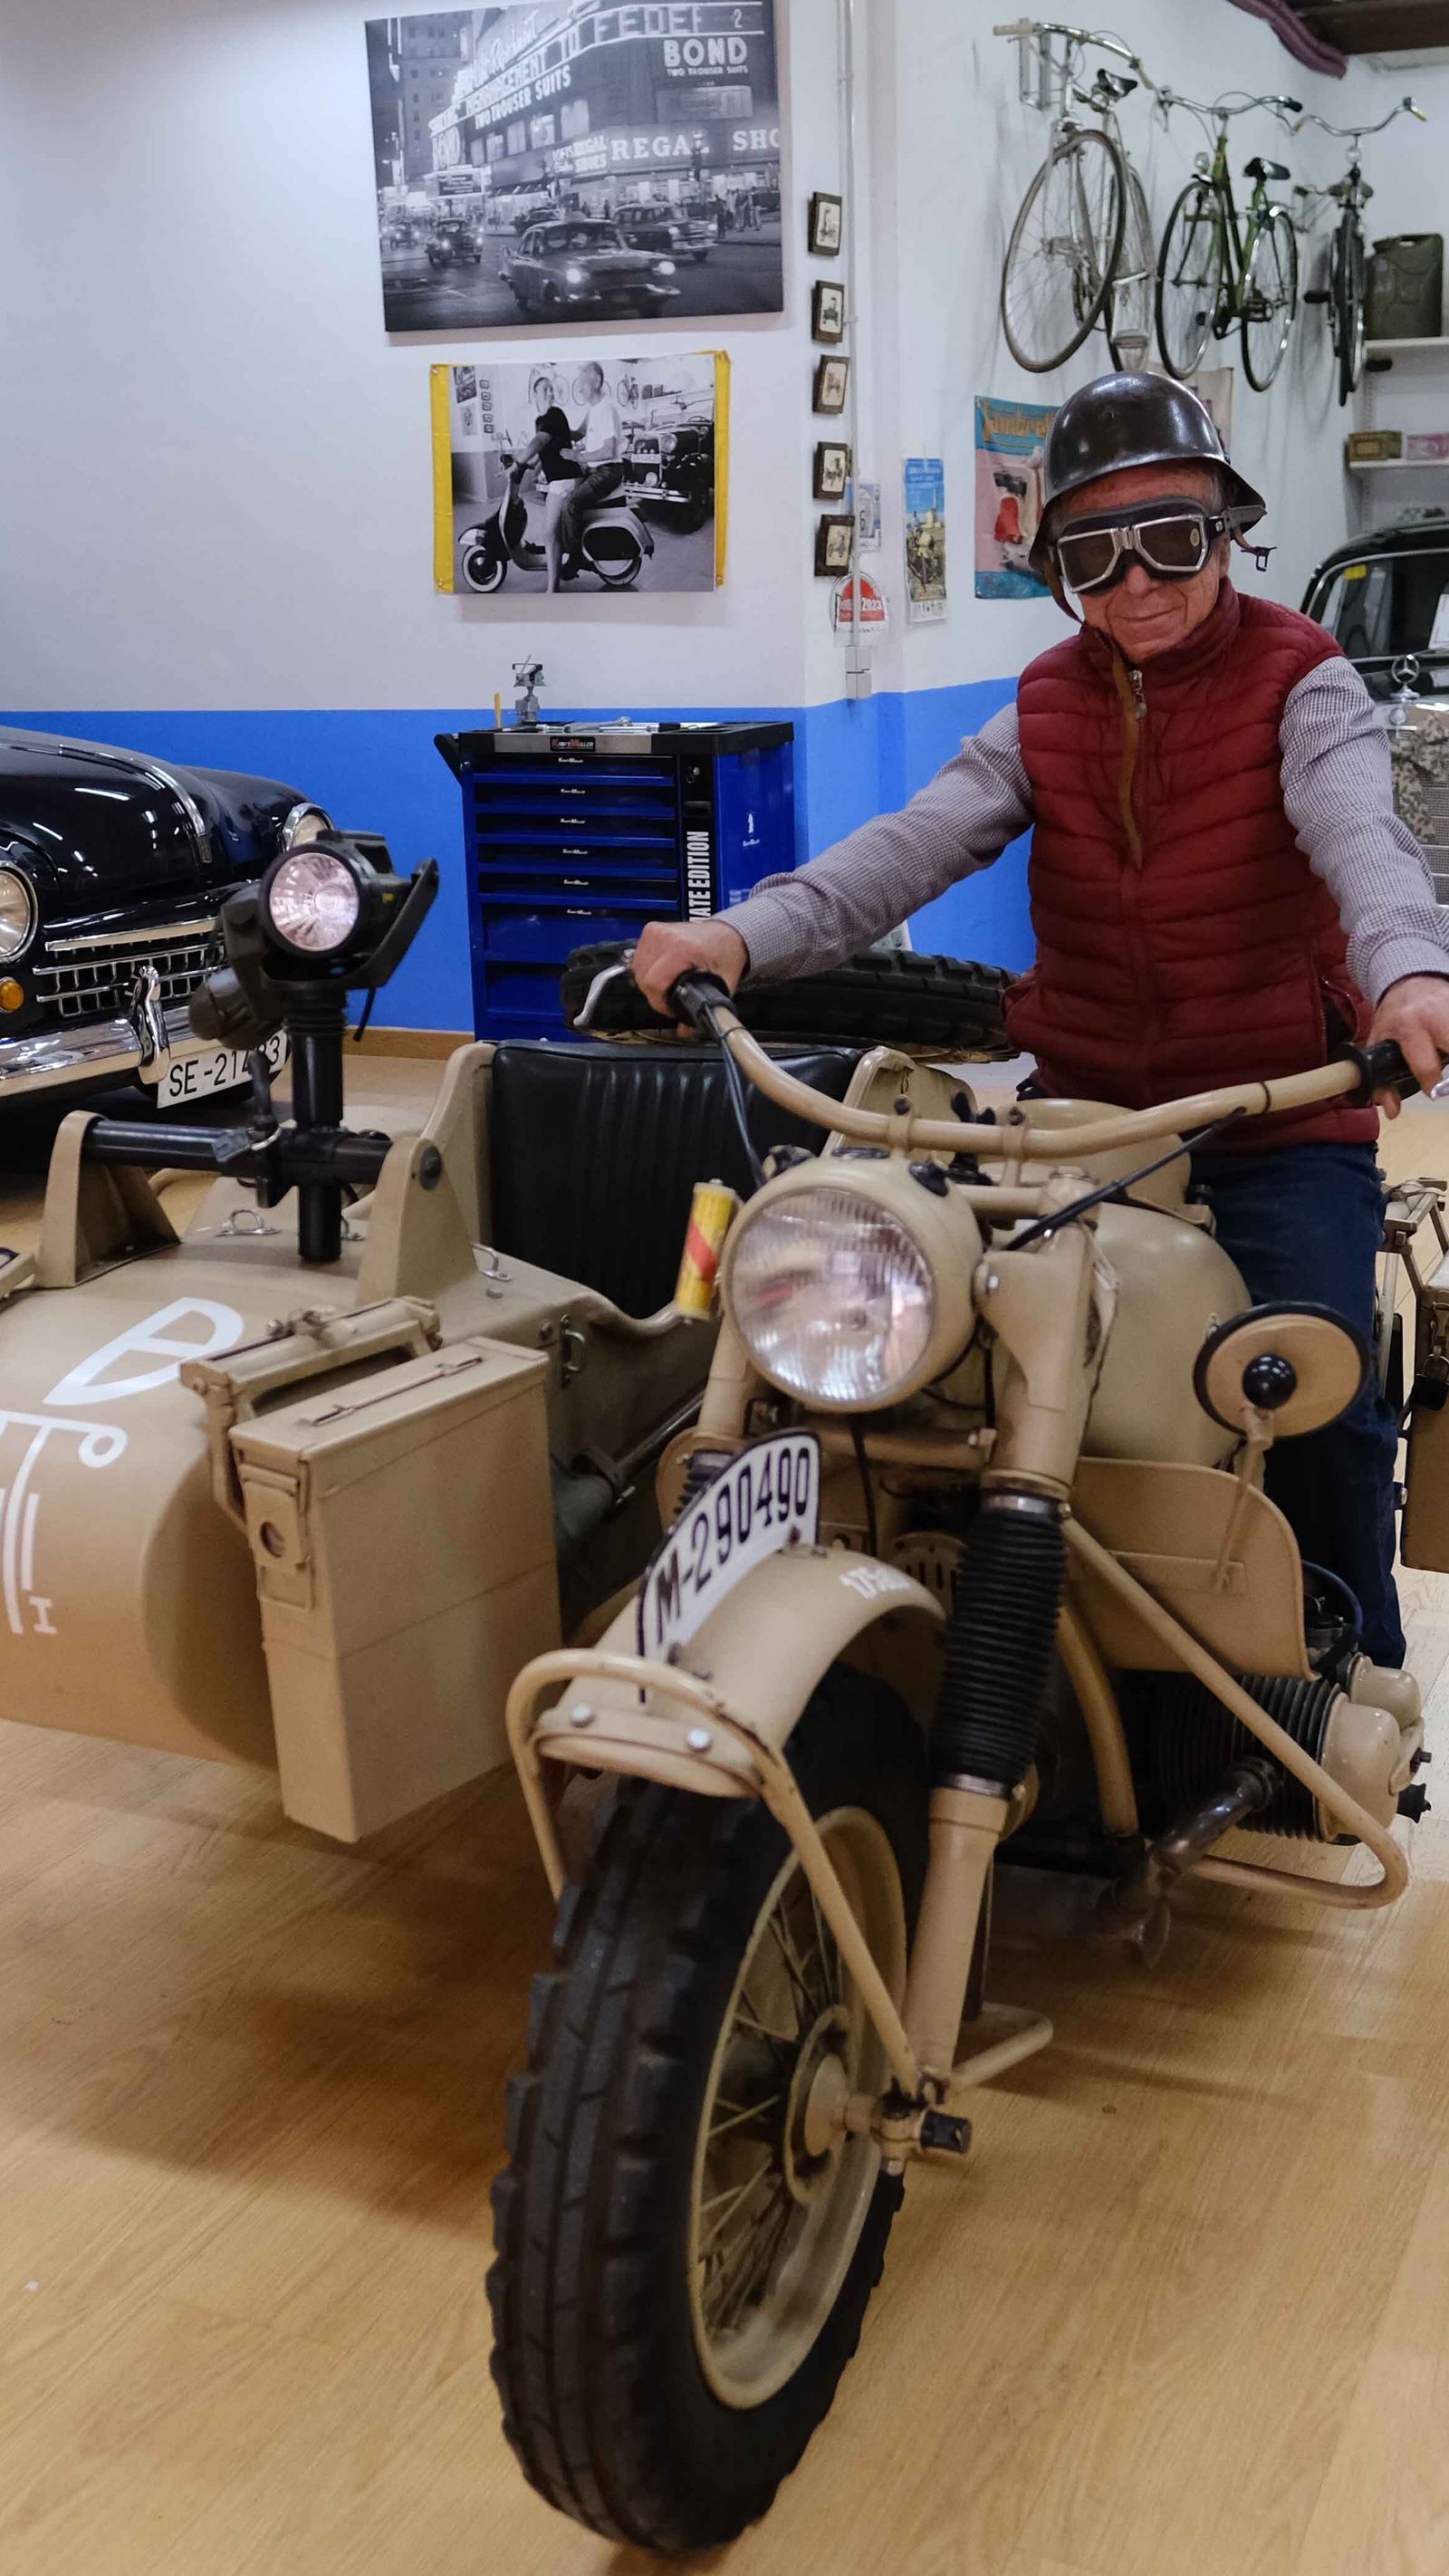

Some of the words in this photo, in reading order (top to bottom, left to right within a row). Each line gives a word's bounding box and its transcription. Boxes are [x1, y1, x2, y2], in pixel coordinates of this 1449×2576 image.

[733, 8, 744, 29] 2
[663, 36, 748, 68] BOND
[667, 68, 686, 77] TWO
[687, 66, 724, 76] TROUSER
[726, 65, 749, 74] SUITS
[474, 108, 491, 130] TWO
[490, 86, 533, 122] TROUSER
[534, 64, 571, 101] SUITS
[686, 831, 711, 889] EDITION
[655, 1447, 811, 1648] M-290490
